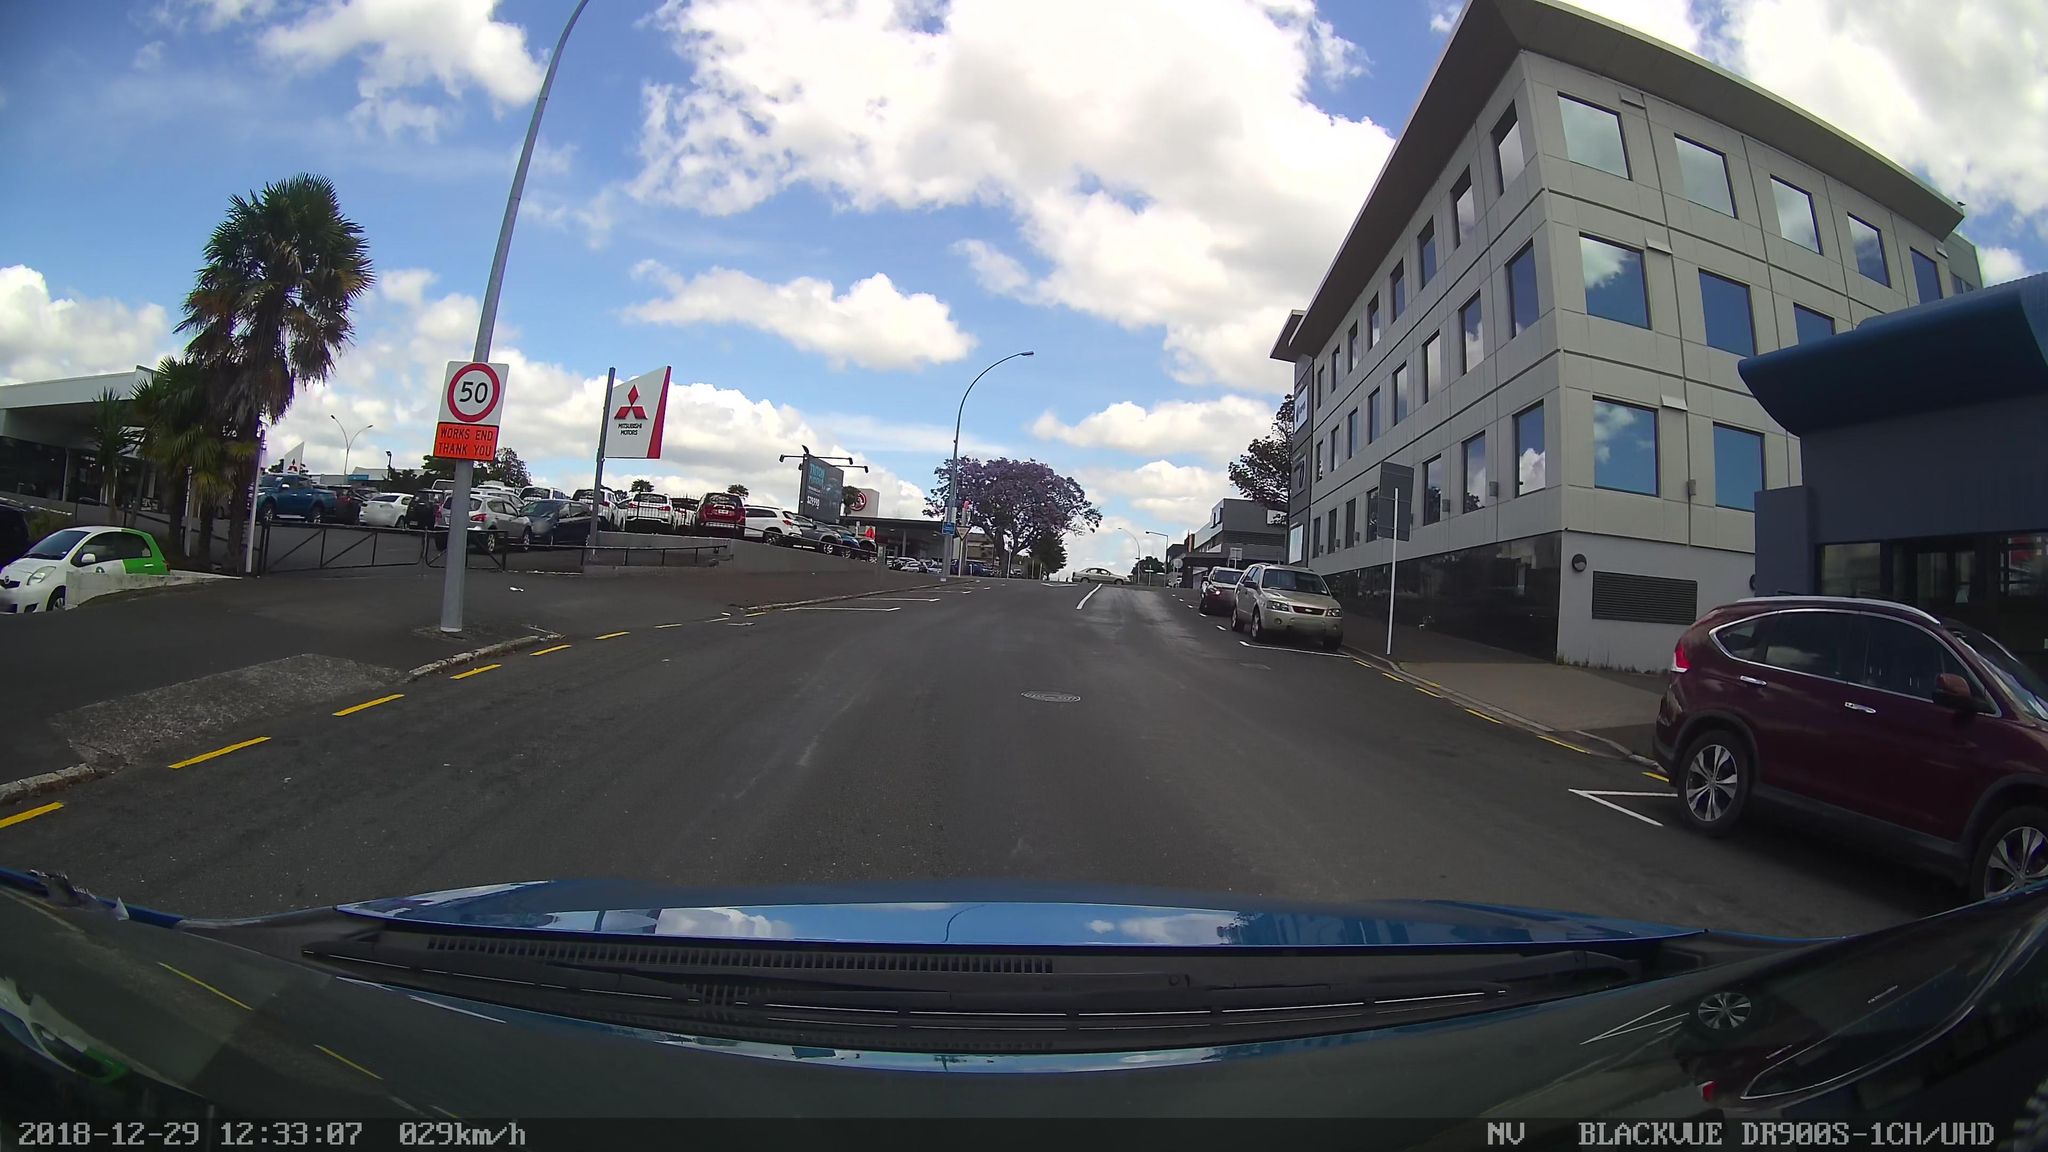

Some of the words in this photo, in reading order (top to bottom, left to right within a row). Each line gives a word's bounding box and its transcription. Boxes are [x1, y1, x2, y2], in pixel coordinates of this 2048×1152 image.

[459, 381, 488, 404] 50
[441, 427, 470, 440] WORKS
[475, 430, 493, 442] END
[439, 442, 468, 456] THANK
[473, 445, 492, 457] YOU
